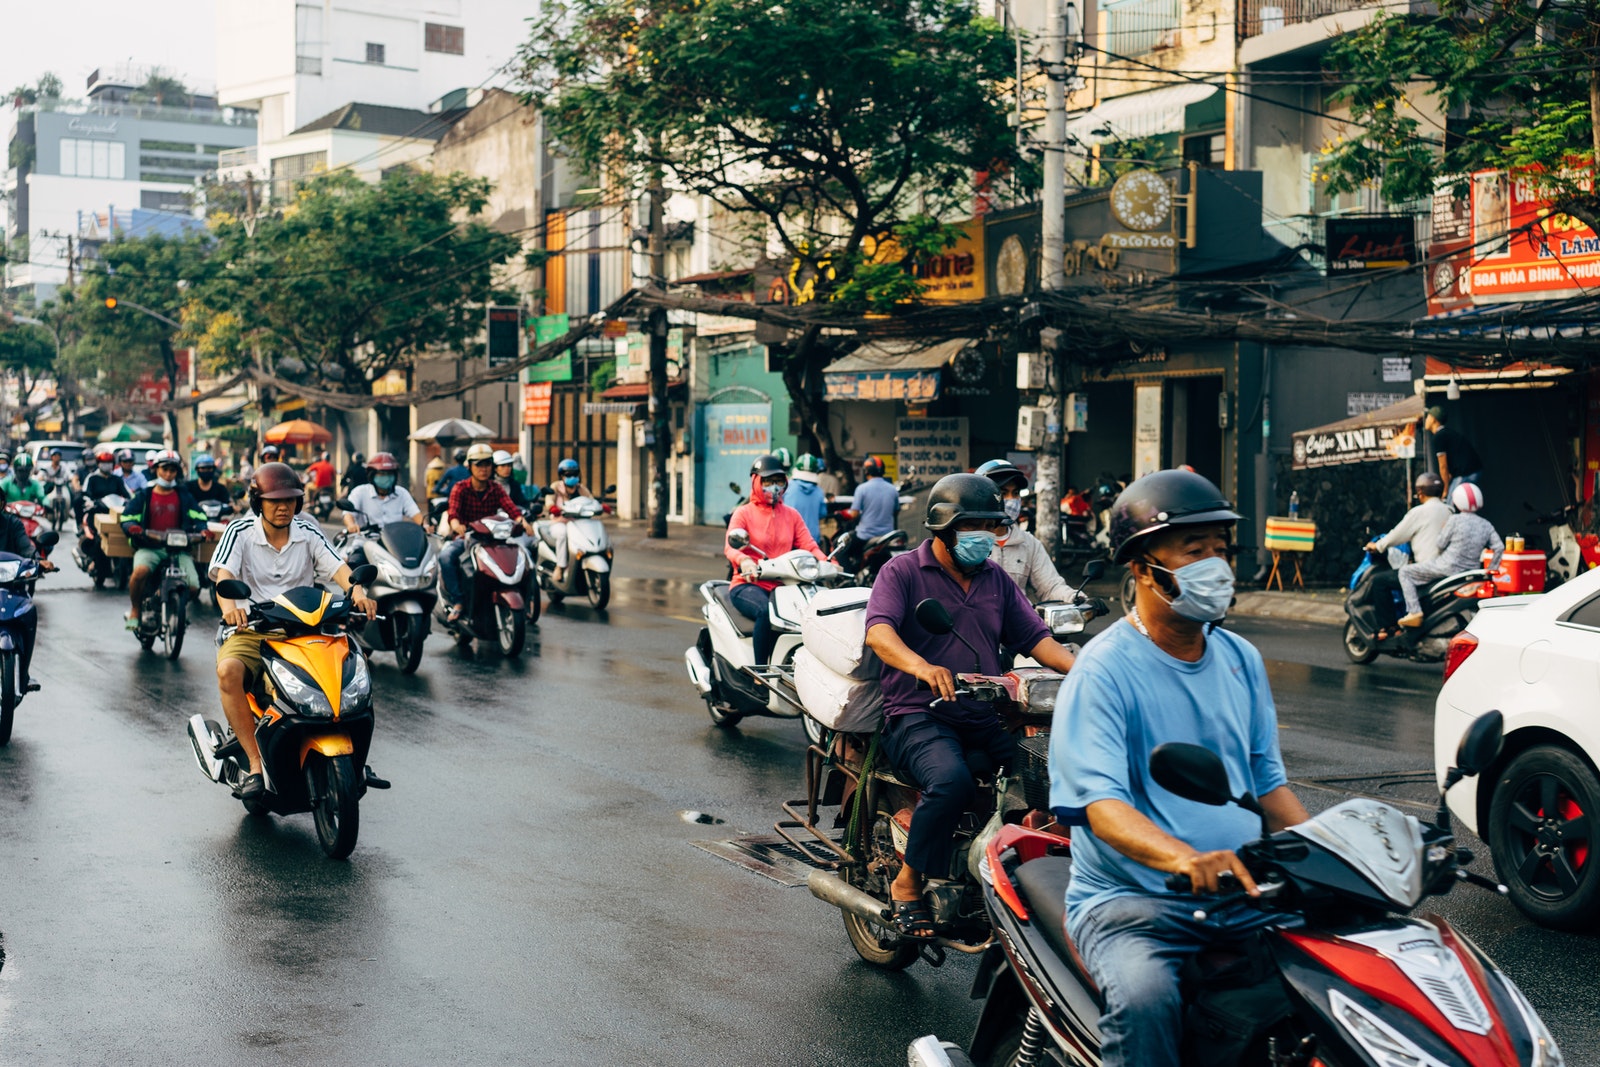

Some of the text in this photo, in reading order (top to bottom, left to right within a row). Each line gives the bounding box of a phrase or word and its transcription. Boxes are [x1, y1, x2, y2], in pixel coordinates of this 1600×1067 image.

[1110, 234, 1175, 247] ToCoToCo
[1500, 267, 1526, 285] HÒA
[1528, 265, 1564, 283] BÌNH,
[1305, 427, 1376, 455] Coffee XINH
